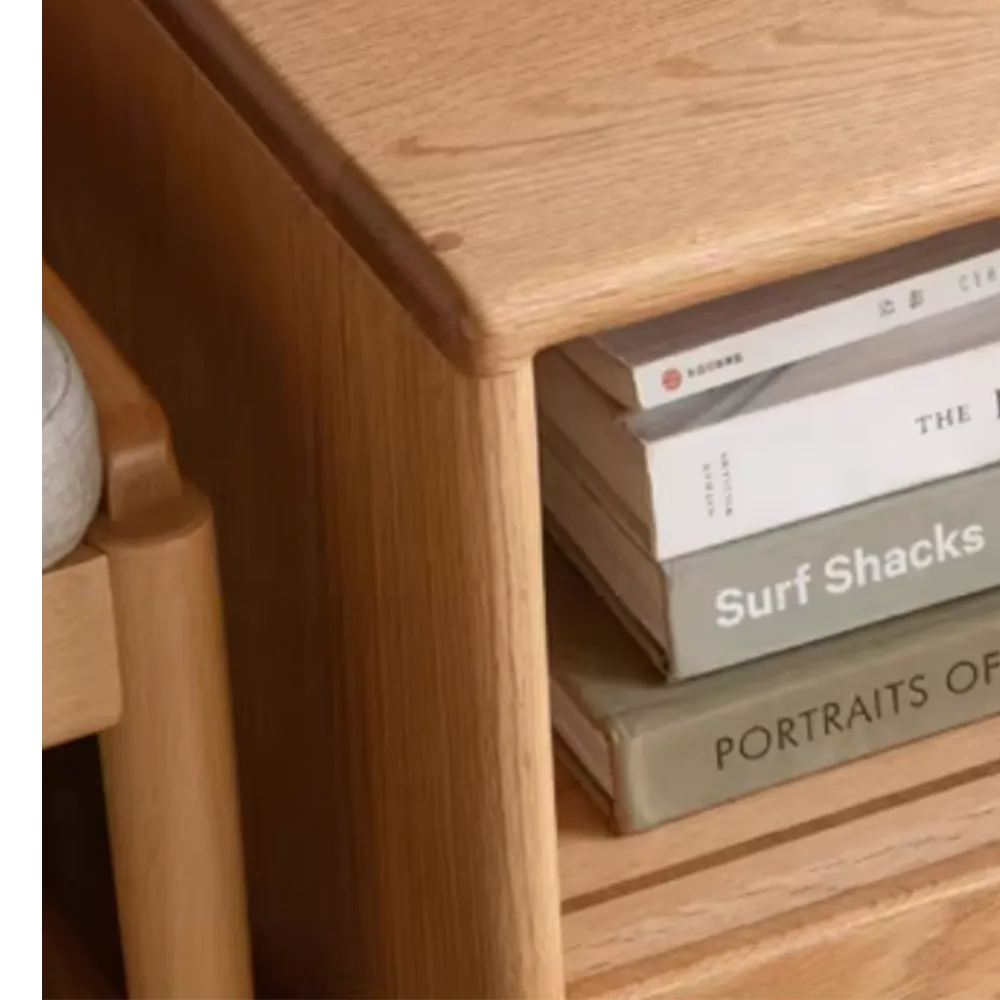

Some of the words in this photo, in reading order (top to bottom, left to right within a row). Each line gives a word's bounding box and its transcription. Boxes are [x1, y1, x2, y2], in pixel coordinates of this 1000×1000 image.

[914, 403, 972, 435] THE
[714, 562, 812, 629] Surf
[823, 522, 986, 595] Shacks
[714, 674, 930, 771] PORTRAITS
